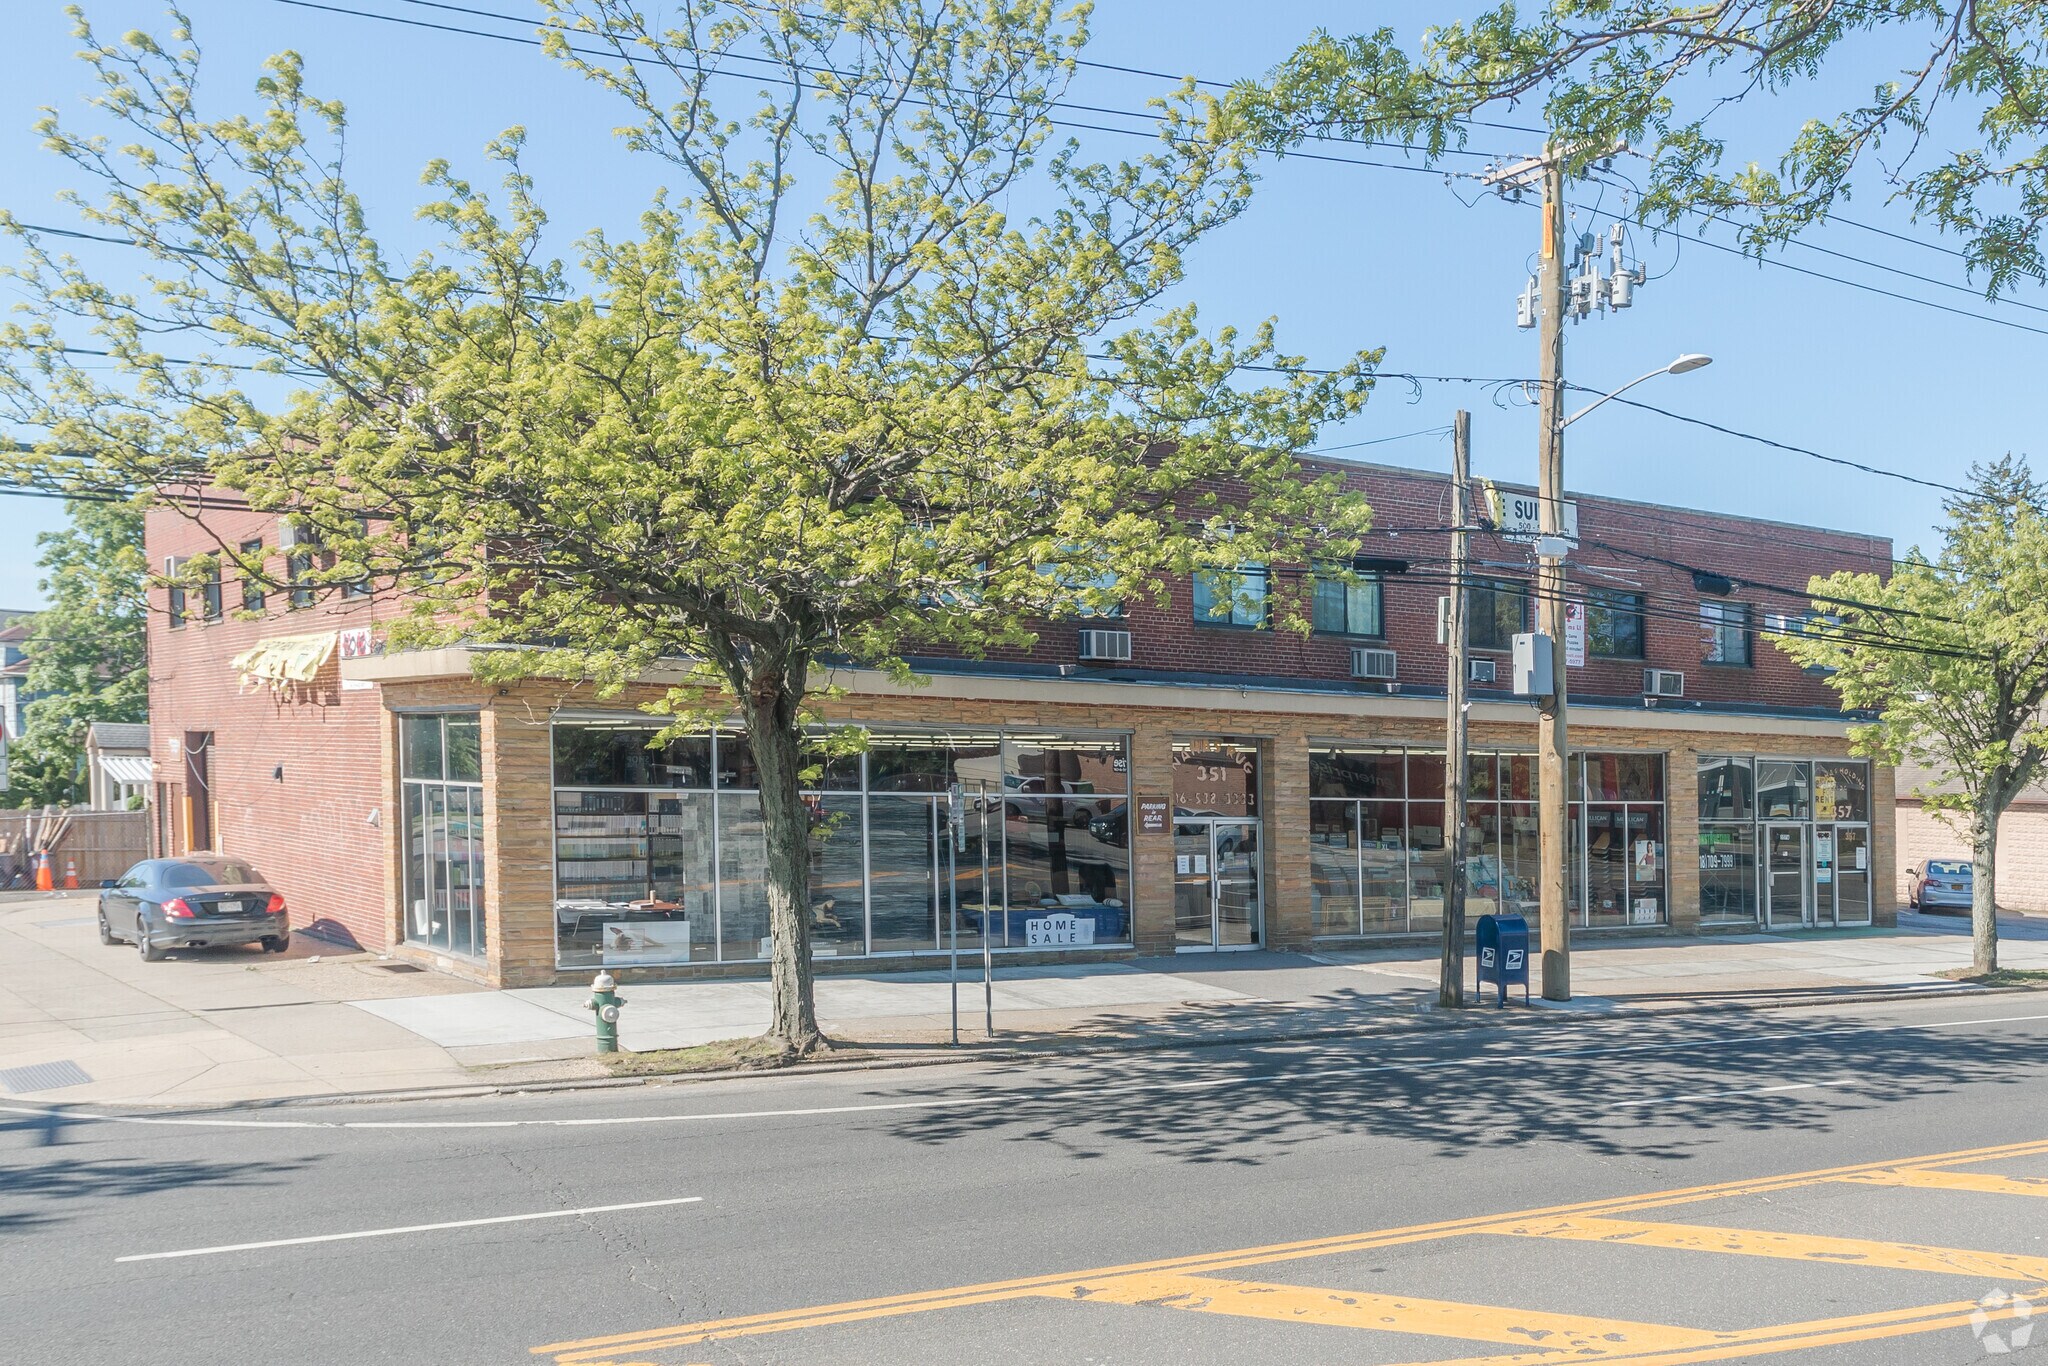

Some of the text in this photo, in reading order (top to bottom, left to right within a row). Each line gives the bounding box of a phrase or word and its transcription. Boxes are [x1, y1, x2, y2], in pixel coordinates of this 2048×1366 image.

[1514, 500, 1539, 520] SUI
[1196, 765, 1227, 781] 351
[1831, 805, 1853, 818] 357
[1143, 814, 1163, 822] REAR
[1030, 920, 1077, 931] HOME
[1031, 932, 1077, 944] SALE
